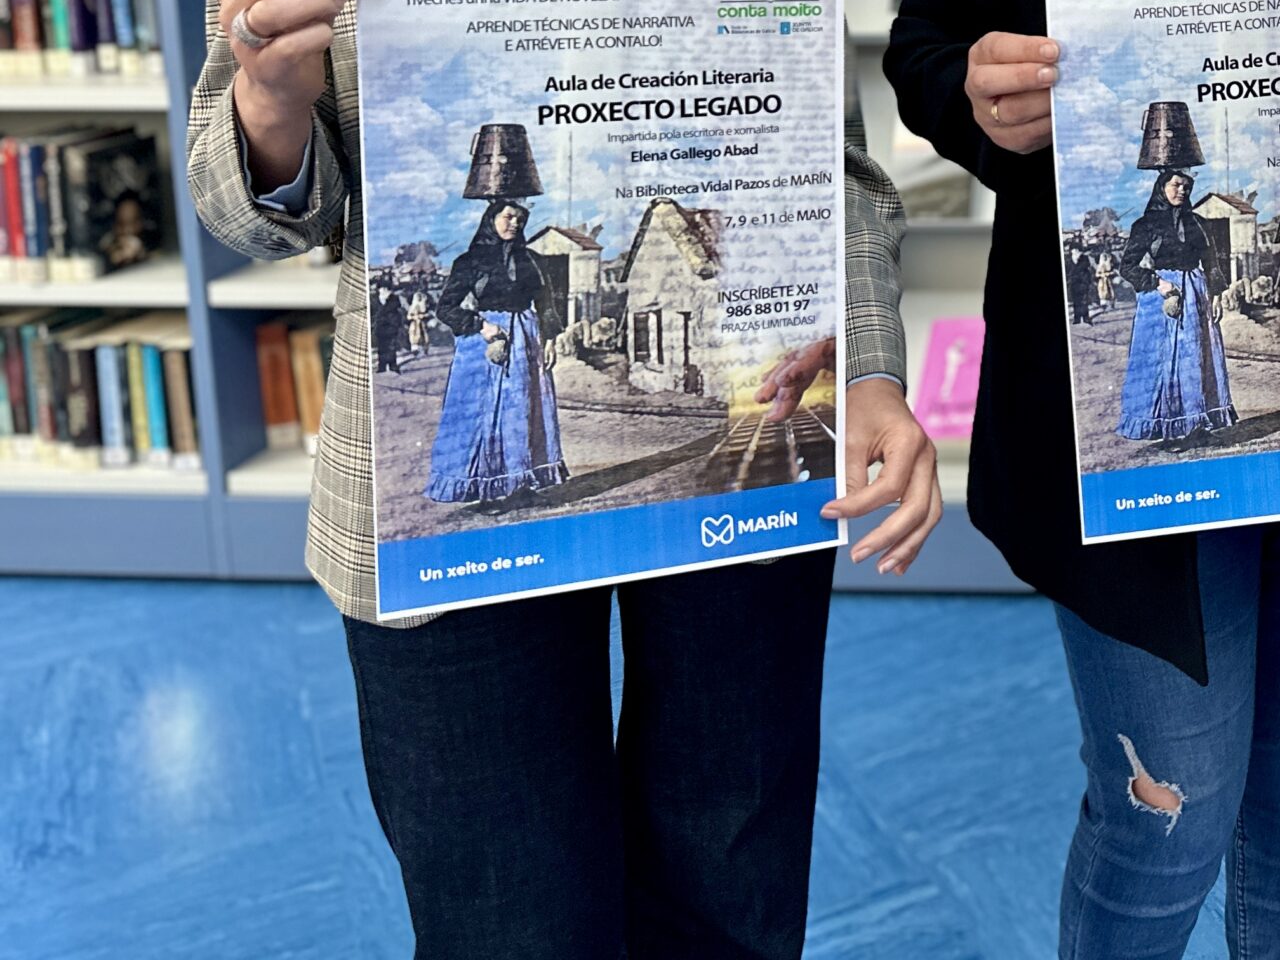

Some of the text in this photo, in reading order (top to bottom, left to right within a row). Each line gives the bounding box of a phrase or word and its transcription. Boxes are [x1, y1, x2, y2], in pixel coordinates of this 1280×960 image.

[717, 2, 822, 18] conta moito
[1133, 5, 1189, 19] APRENDE
[1189, 1, 1247, 16] TÉCNICAS
[1248, 0, 1265, 12] DE
[466, 15, 695, 34] APRENDE TÉCNICAS DE NARRATIVA
[1166, 24, 1173, 36] E
[1175, 20, 1232, 35] ATRÉVETE
[1233, 19, 1243, 31] A
[504, 34, 662, 52] E ATRÉVETE A CONTALO!
[1202, 55, 1239, 72] Aula
[1241, 53, 1263, 69] de
[544, 70, 774, 92] Aula de Creación Literaria
[537, 94, 782, 125] PROXECTO LEGADO
[630, 143, 758, 163] Elena Gallego Abad
[615, 170, 832, 198] Na Biblioteca Vidal Pazos de MARÍN
[717, 282, 818, 303] INSCRÍBETE XA!
[725, 298, 810, 318] 986 88 01 97
[1116, 489, 1220, 510] Un xeito de ser.
[737, 510, 797, 534] MARÍN
[419, 554, 544, 581] Un xeito de ser.
